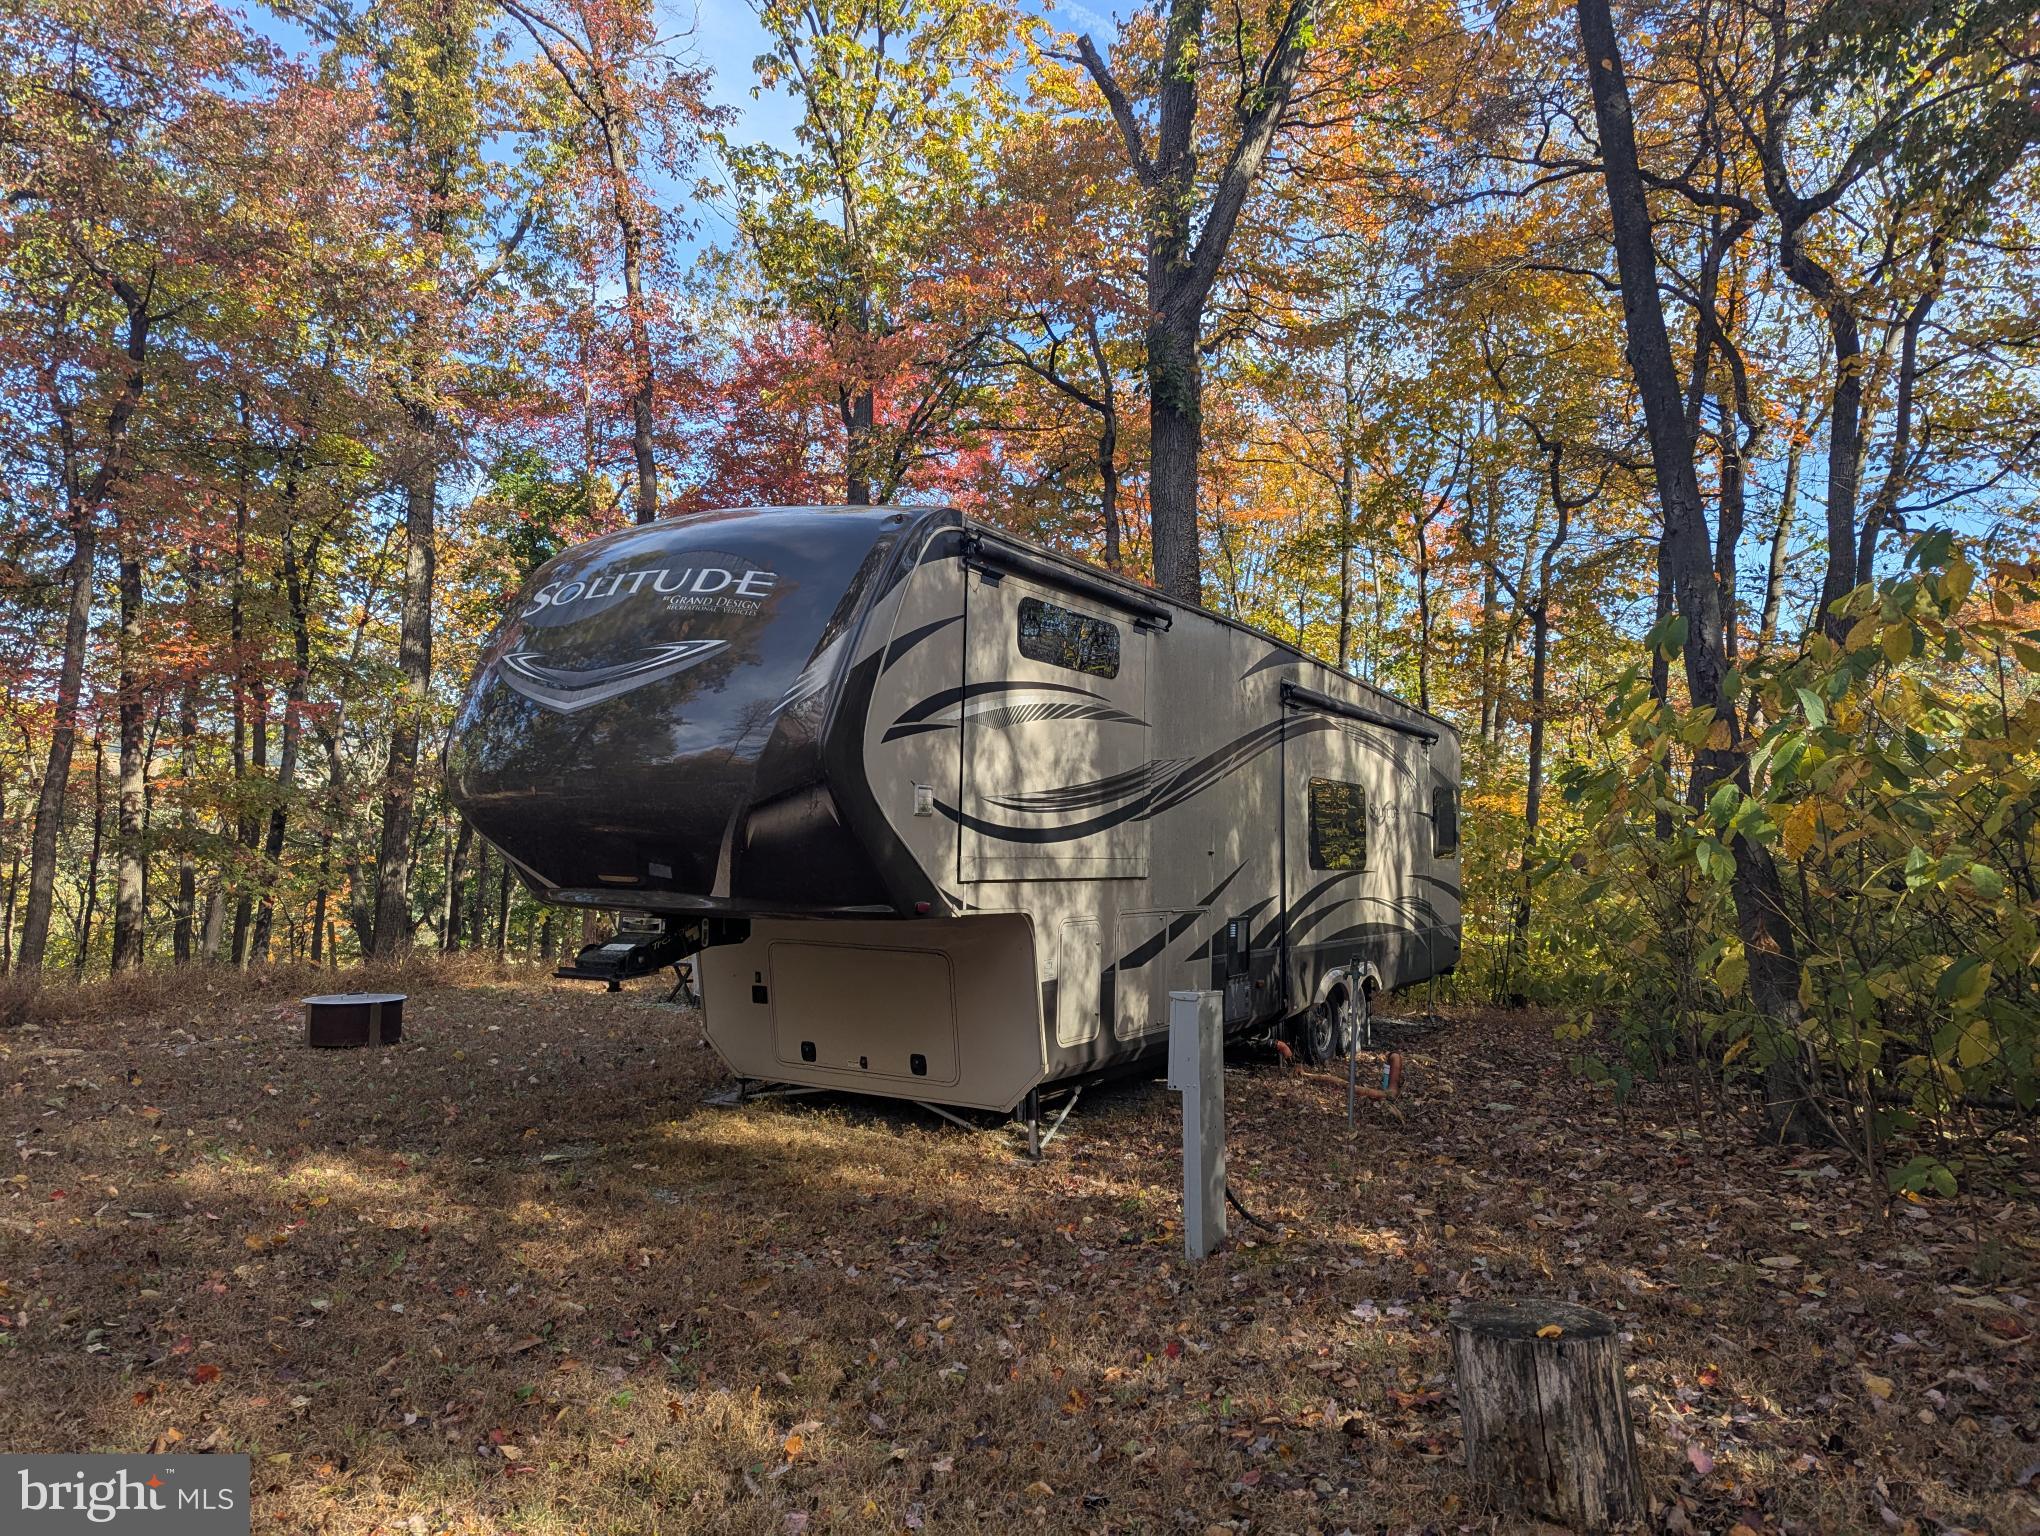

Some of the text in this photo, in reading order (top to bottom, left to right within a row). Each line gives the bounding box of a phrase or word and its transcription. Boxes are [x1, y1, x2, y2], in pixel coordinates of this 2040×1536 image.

[520, 567, 778, 618] SOLITUDE
[670, 594, 713, 606] GRAND
[715, 596, 762, 610] DESIGN
[666, 604, 758, 617] RECREATIONAL VEHICLES
